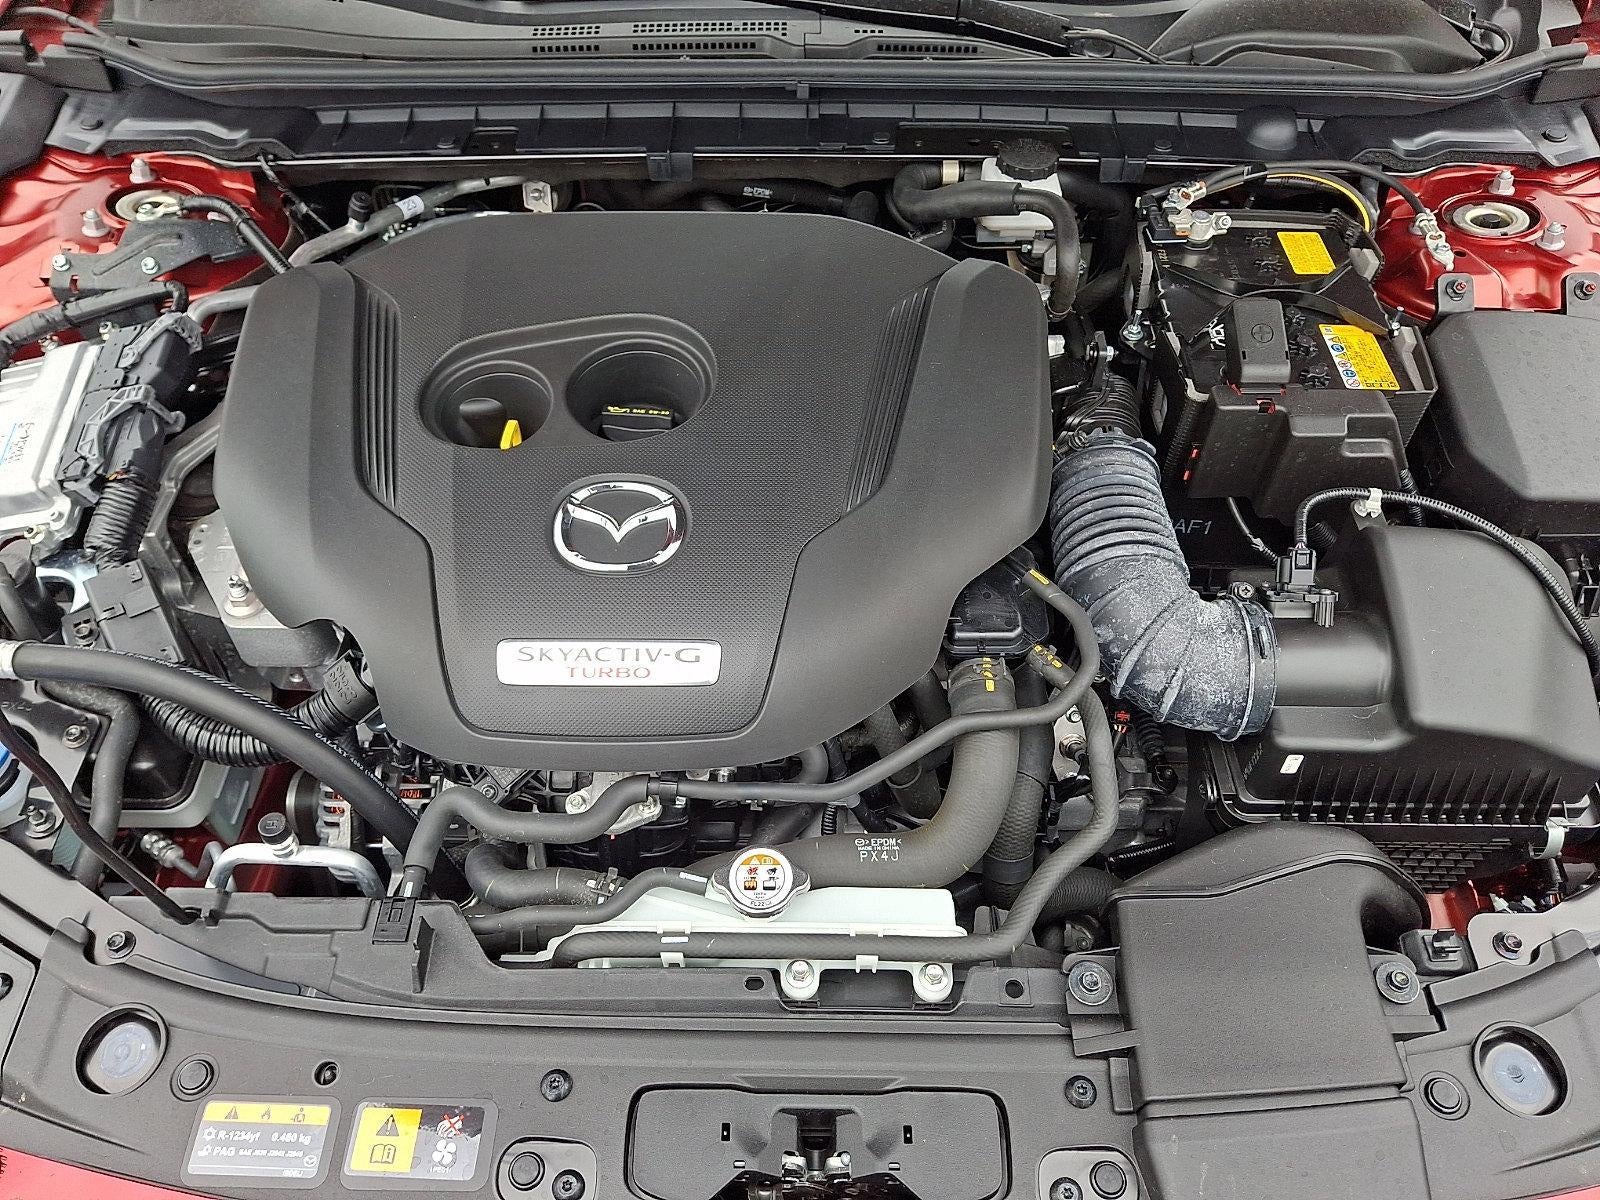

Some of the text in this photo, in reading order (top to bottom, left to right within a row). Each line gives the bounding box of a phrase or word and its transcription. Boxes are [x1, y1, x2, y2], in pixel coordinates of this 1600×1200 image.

[1170, 518, 1212, 535] AF1
[517, 646, 701, 663] SKYACTIV-G
[567, 666, 651, 679] TURBO
[315, 732, 349, 757] GALAXY
[859, 850, 899, 862] PX4J
[299, 1133, 312, 1146] kg
[213, 1146, 236, 1157] PAG
